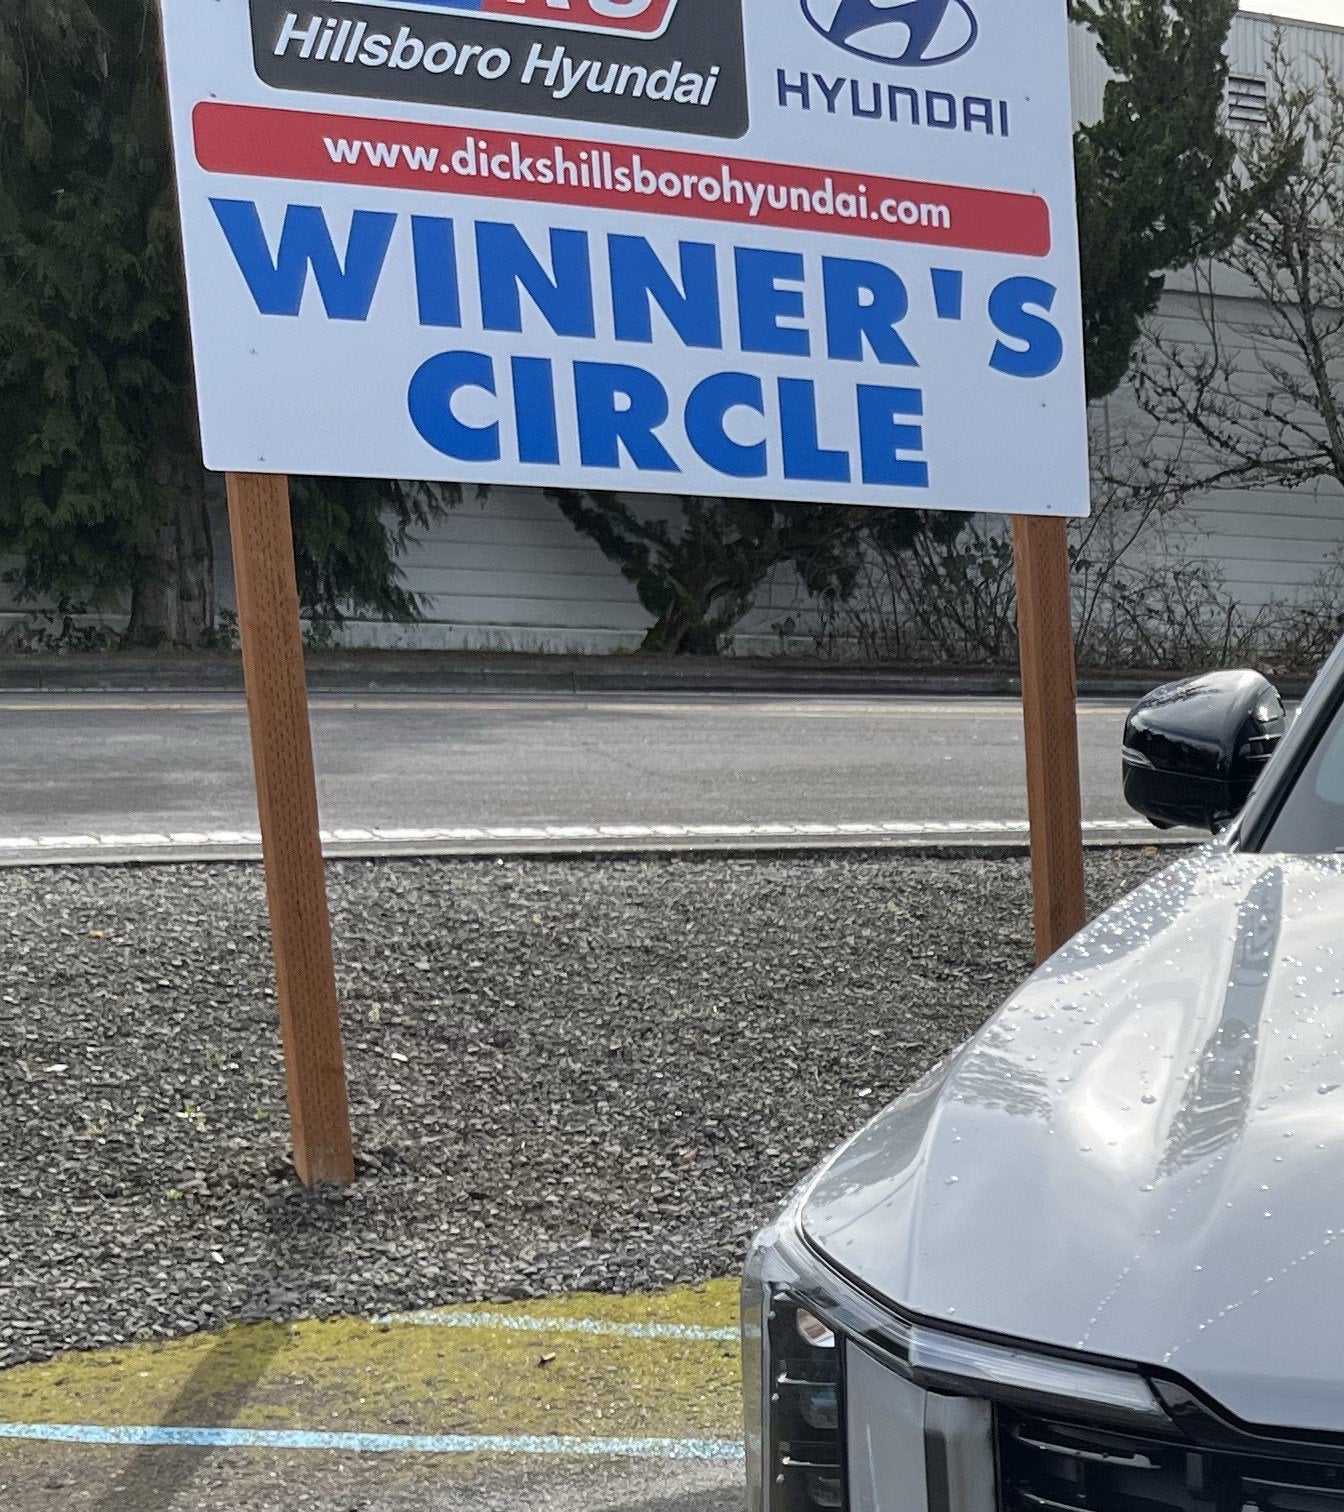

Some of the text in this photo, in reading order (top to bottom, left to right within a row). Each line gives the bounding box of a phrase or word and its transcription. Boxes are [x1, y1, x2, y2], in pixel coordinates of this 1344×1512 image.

[274, 13, 720, 106] Hillsboro Hyundai
[777, 69, 1009, 137] HYUNDAI
[324, 135, 951, 229] www.dickshillsborohyundai.com
[209, 198, 1063, 378] WINNER'S
[407, 350, 929, 488] CIRCLE
